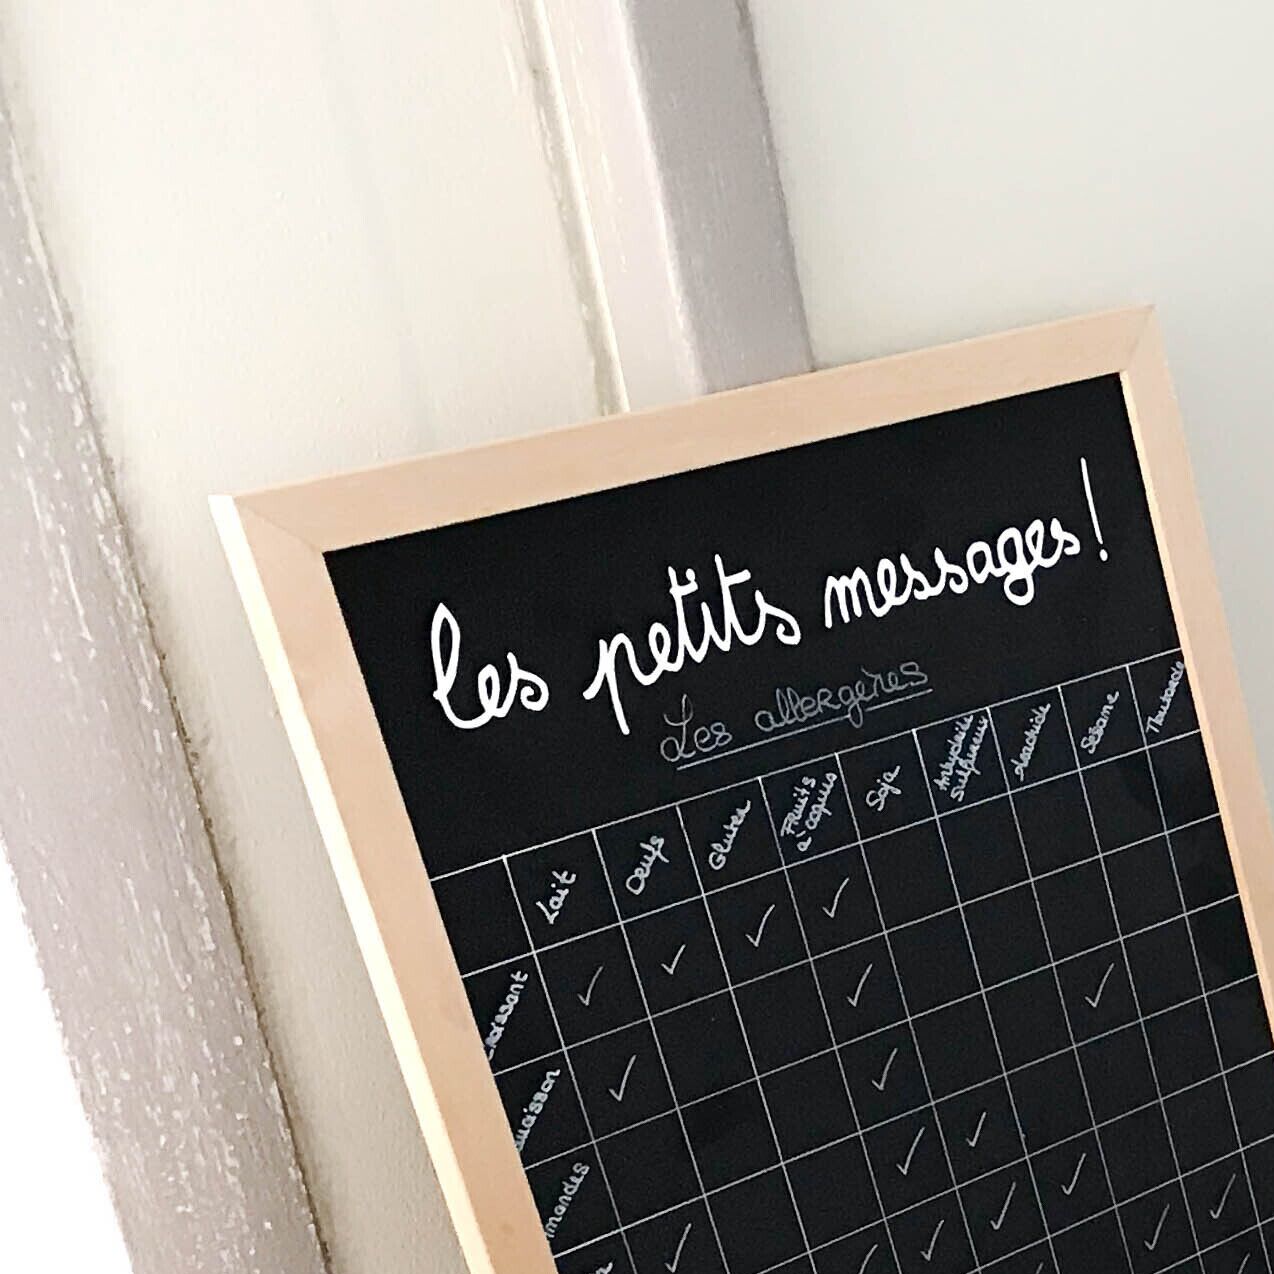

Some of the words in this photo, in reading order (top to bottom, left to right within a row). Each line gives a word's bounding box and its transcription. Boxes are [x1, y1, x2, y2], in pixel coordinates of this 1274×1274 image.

[431, 603, 549, 728] les
[583, 554, 801, 734] petits
[661, 695, 732, 762] Les
[866, 766, 901, 811] Soja
[709, 800, 751, 870] Gluten
[536, 871, 576, 924] Lait
